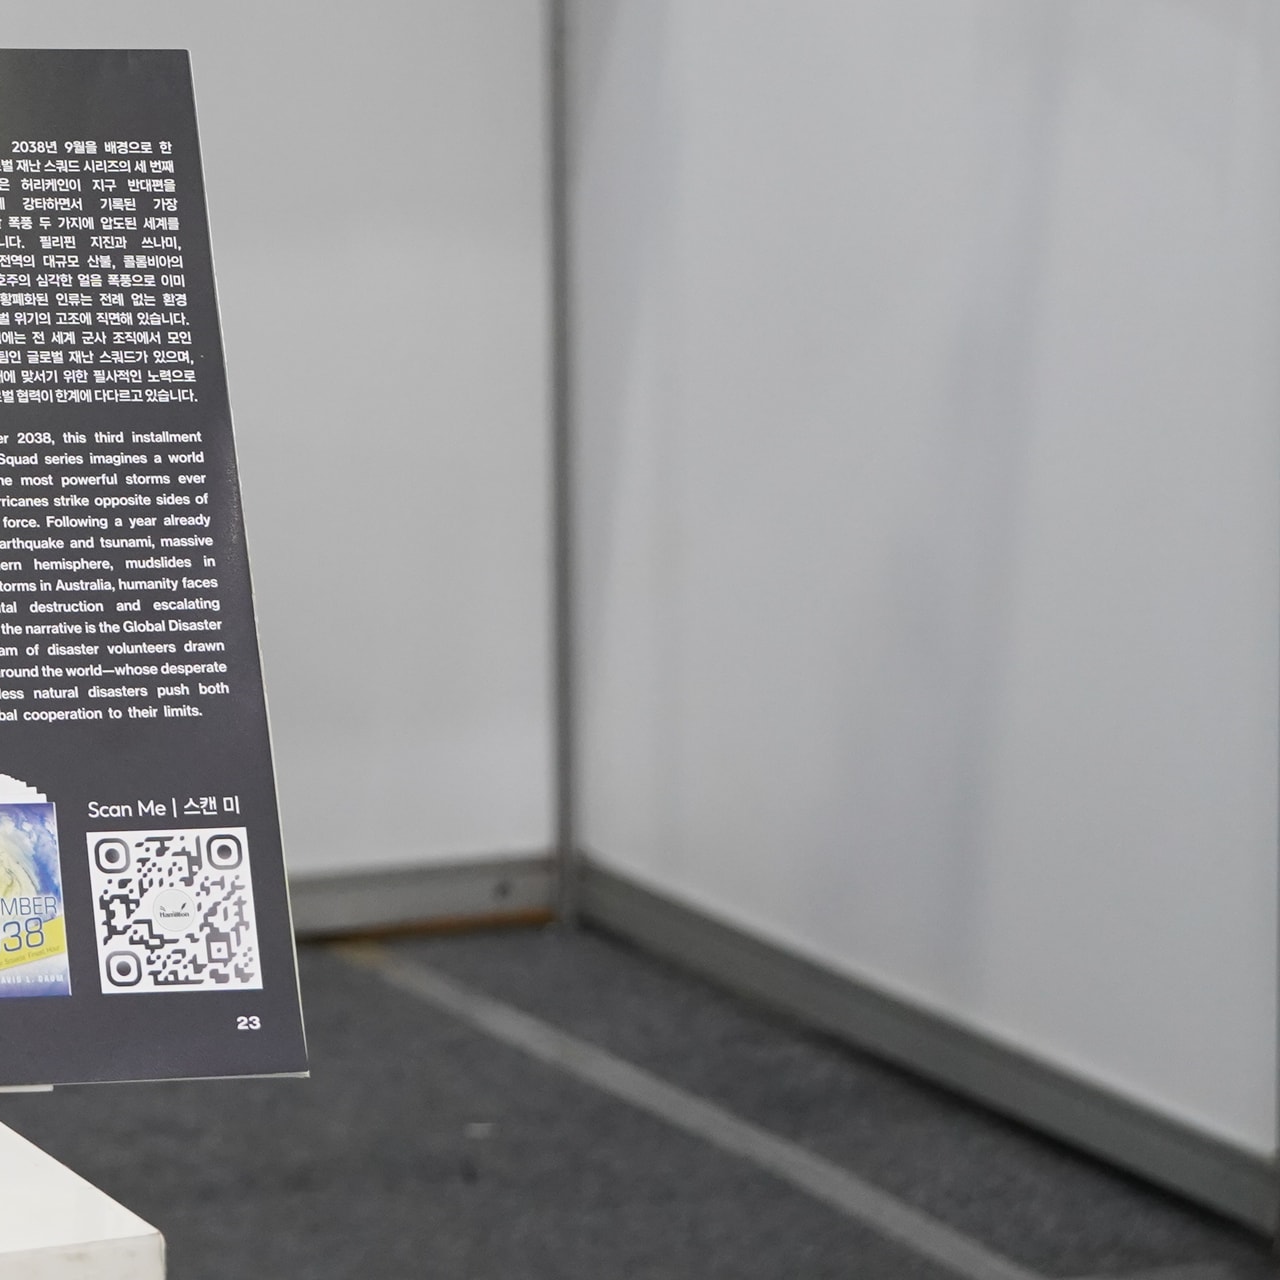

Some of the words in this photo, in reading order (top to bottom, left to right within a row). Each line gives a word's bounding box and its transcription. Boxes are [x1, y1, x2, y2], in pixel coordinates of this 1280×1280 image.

[11, 140, 58, 155] 2038년
[63, 140, 98, 155] 9월을
[103, 140, 154, 155] 배경으로
[158, 140, 173, 155] 한
[38, 235, 77, 250] 필리핀
[89, 235, 128, 250] 지진과
[141, 235, 182, 252] 쓰나미,
[16, 431, 56, 446] 2038,
[62, 431, 88, 444] this
[93, 430, 125, 444] third
[131, 430, 203, 444] installment
[22, 707, 104, 723] cooperation
[107, 707, 123, 720] to
[127, 705, 159, 719] their
[163, 704, 203, 718] limits.
[87, 801, 133, 819] Scan
[137, 799, 167, 817] Me
[183, 795, 218, 816] 스캔
[222, 795, 241, 815] 미
[236, 1015, 262, 1031] 23
